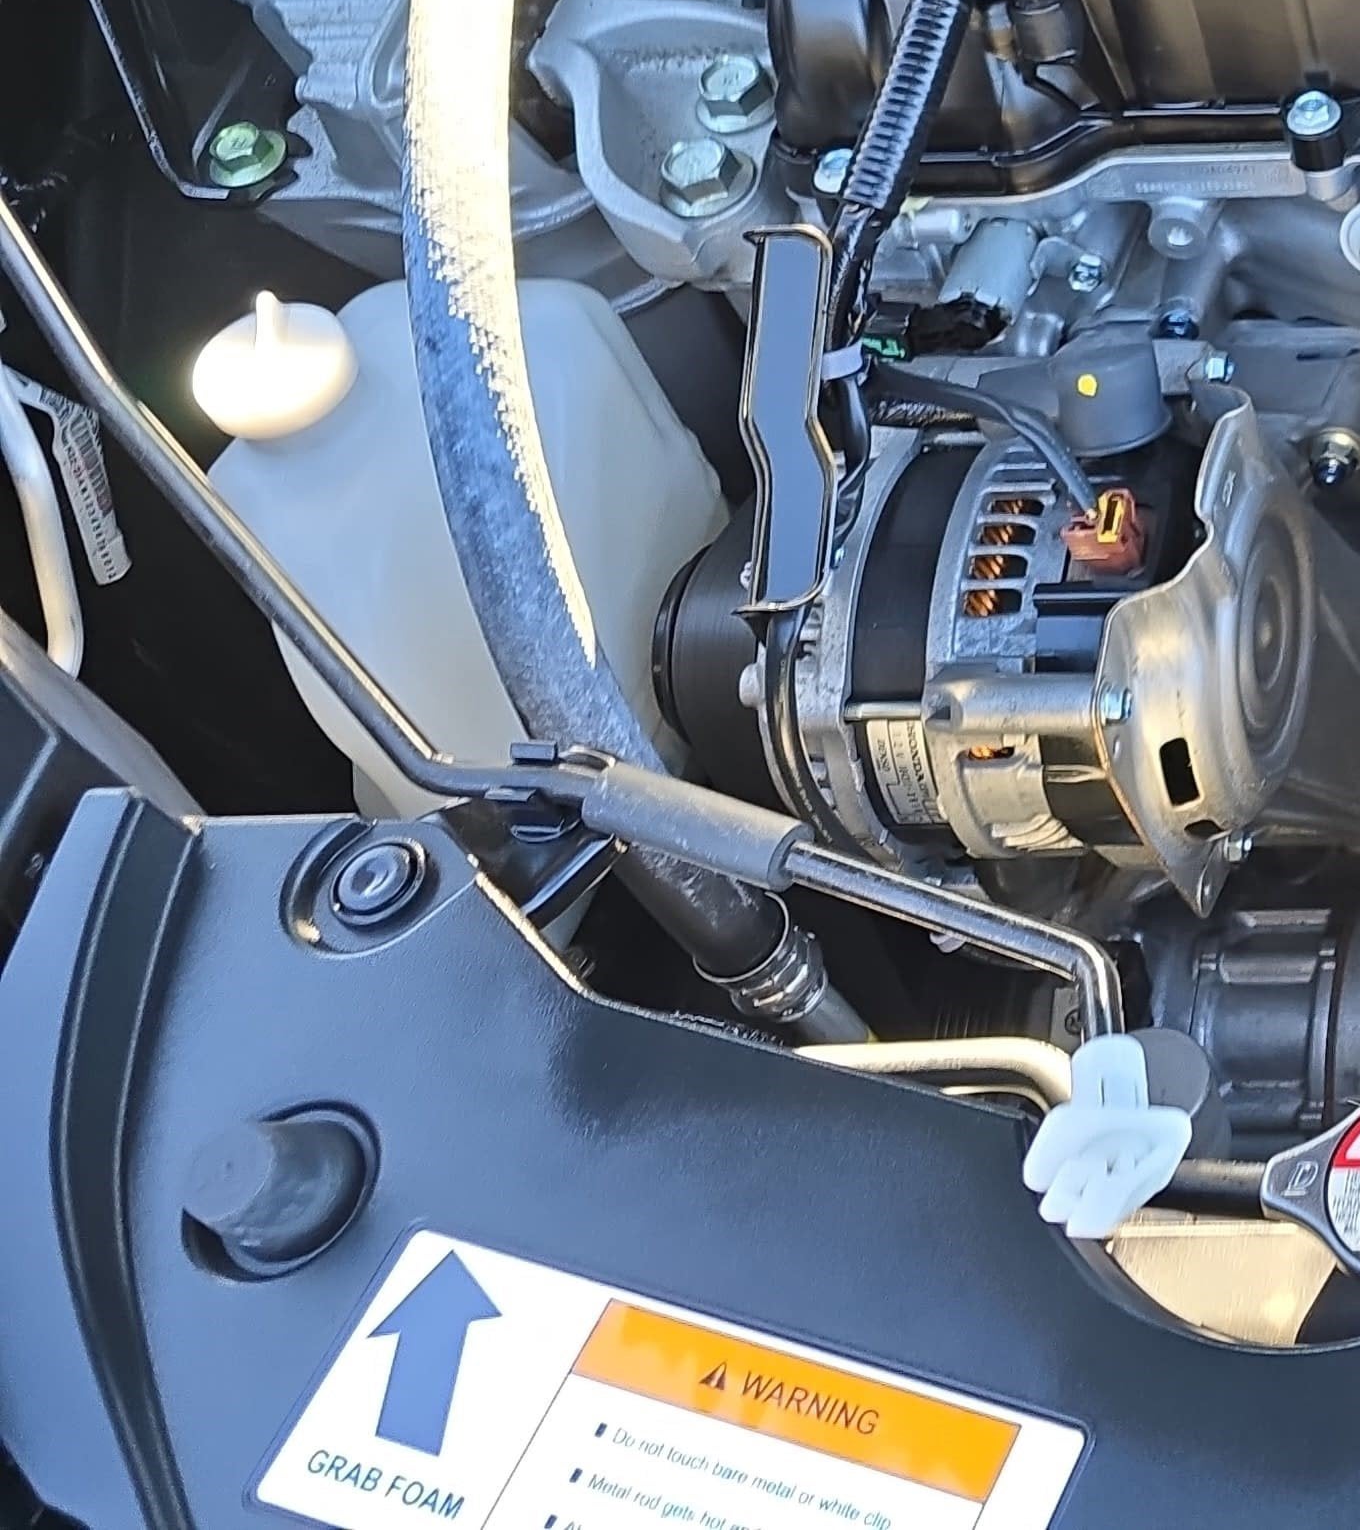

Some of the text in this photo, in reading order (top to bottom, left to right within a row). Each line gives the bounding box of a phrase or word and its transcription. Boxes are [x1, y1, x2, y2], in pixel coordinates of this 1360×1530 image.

[742, 1371, 880, 1435] WARNING
[307, 1449, 465, 1520] GRAB FOAM
[588, 1473, 633, 1500] Metal
[633, 1491, 662, 1510] rod
[661, 1501, 696, 1522] gets
[612, 1427, 636, 1447] Do
[638, 1440, 665, 1457] not
[667, 1446, 709, 1471] touch
[711, 1462, 748, 1484] bare
[751, 1475, 798, 1500] metal
[798, 1490, 816, 1506] or
[818, 1498, 861, 1521] white
